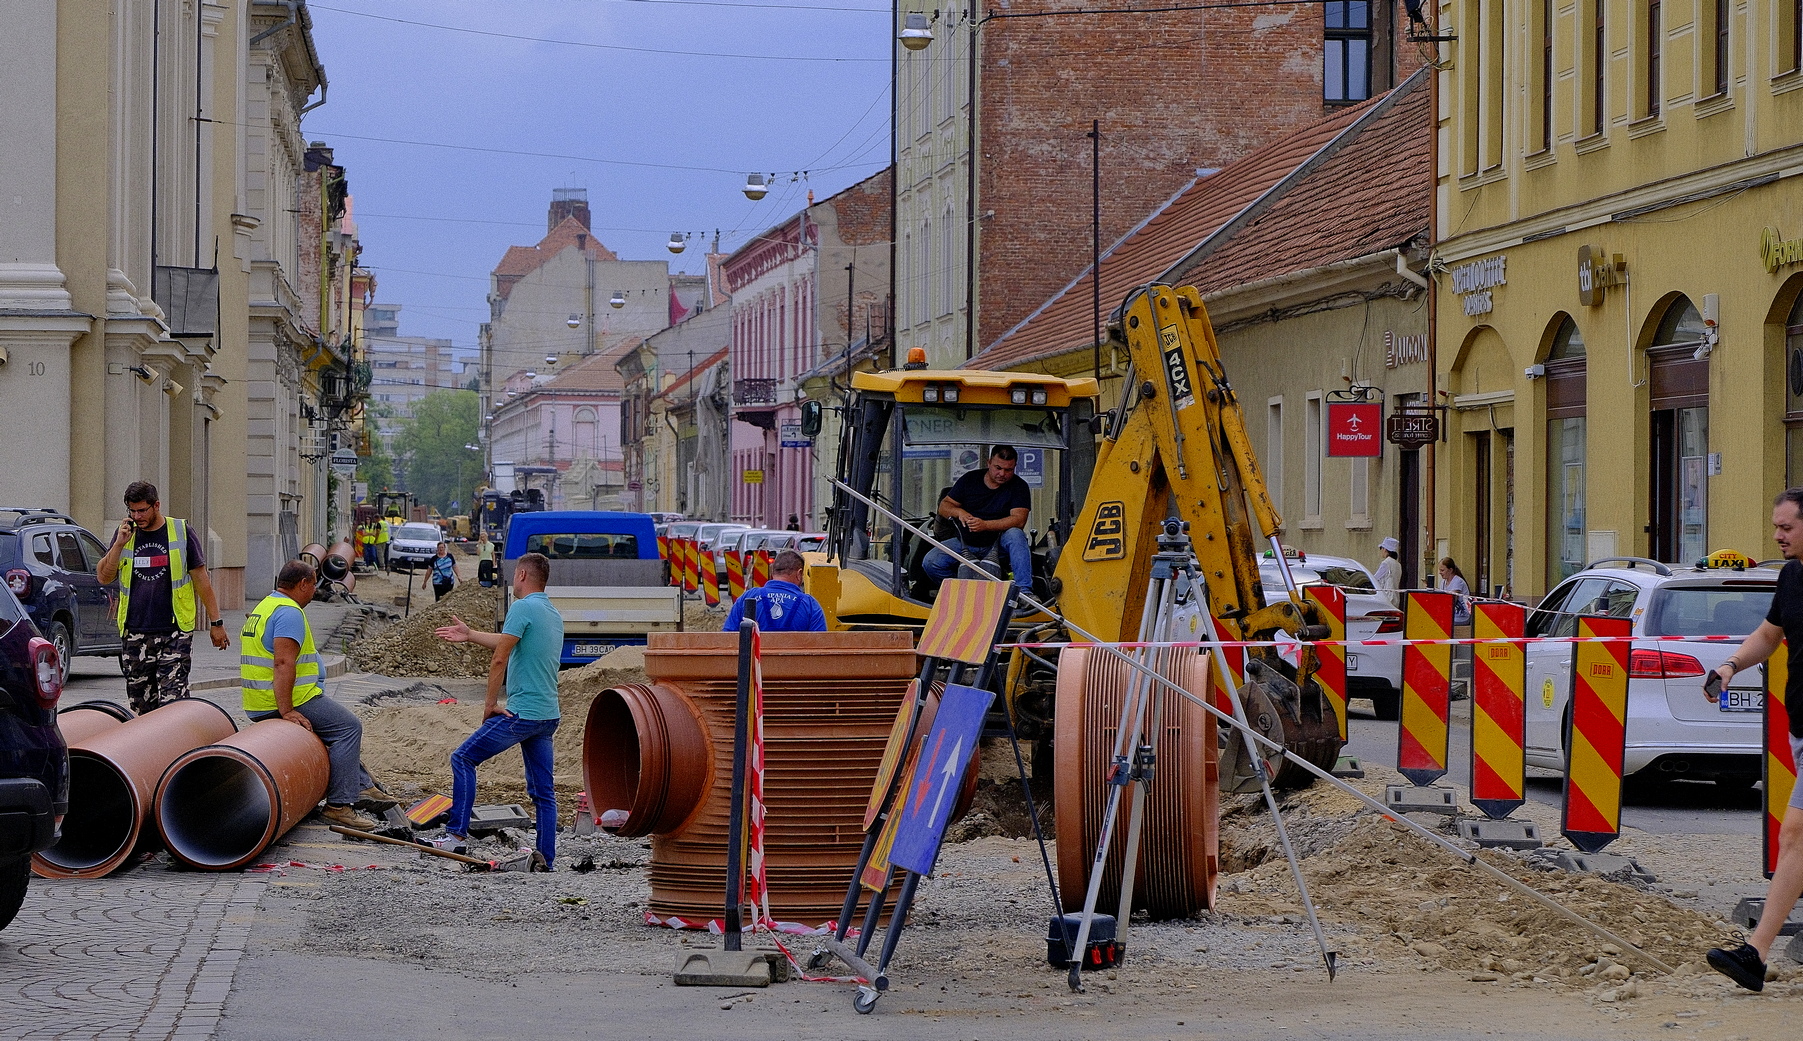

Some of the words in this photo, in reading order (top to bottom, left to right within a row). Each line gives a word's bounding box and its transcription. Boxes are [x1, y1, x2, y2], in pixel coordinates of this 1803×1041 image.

[1579, 259, 1593, 292] tbi
[28, 361, 46, 377] 10
[1168, 352, 1190, 396] 4CX
[1088, 504, 1122, 555] JCB
[1712, 559, 1745, 567] TAXI
[575, 645, 587, 654] BH
[1729, 692, 1751, 707] BH
